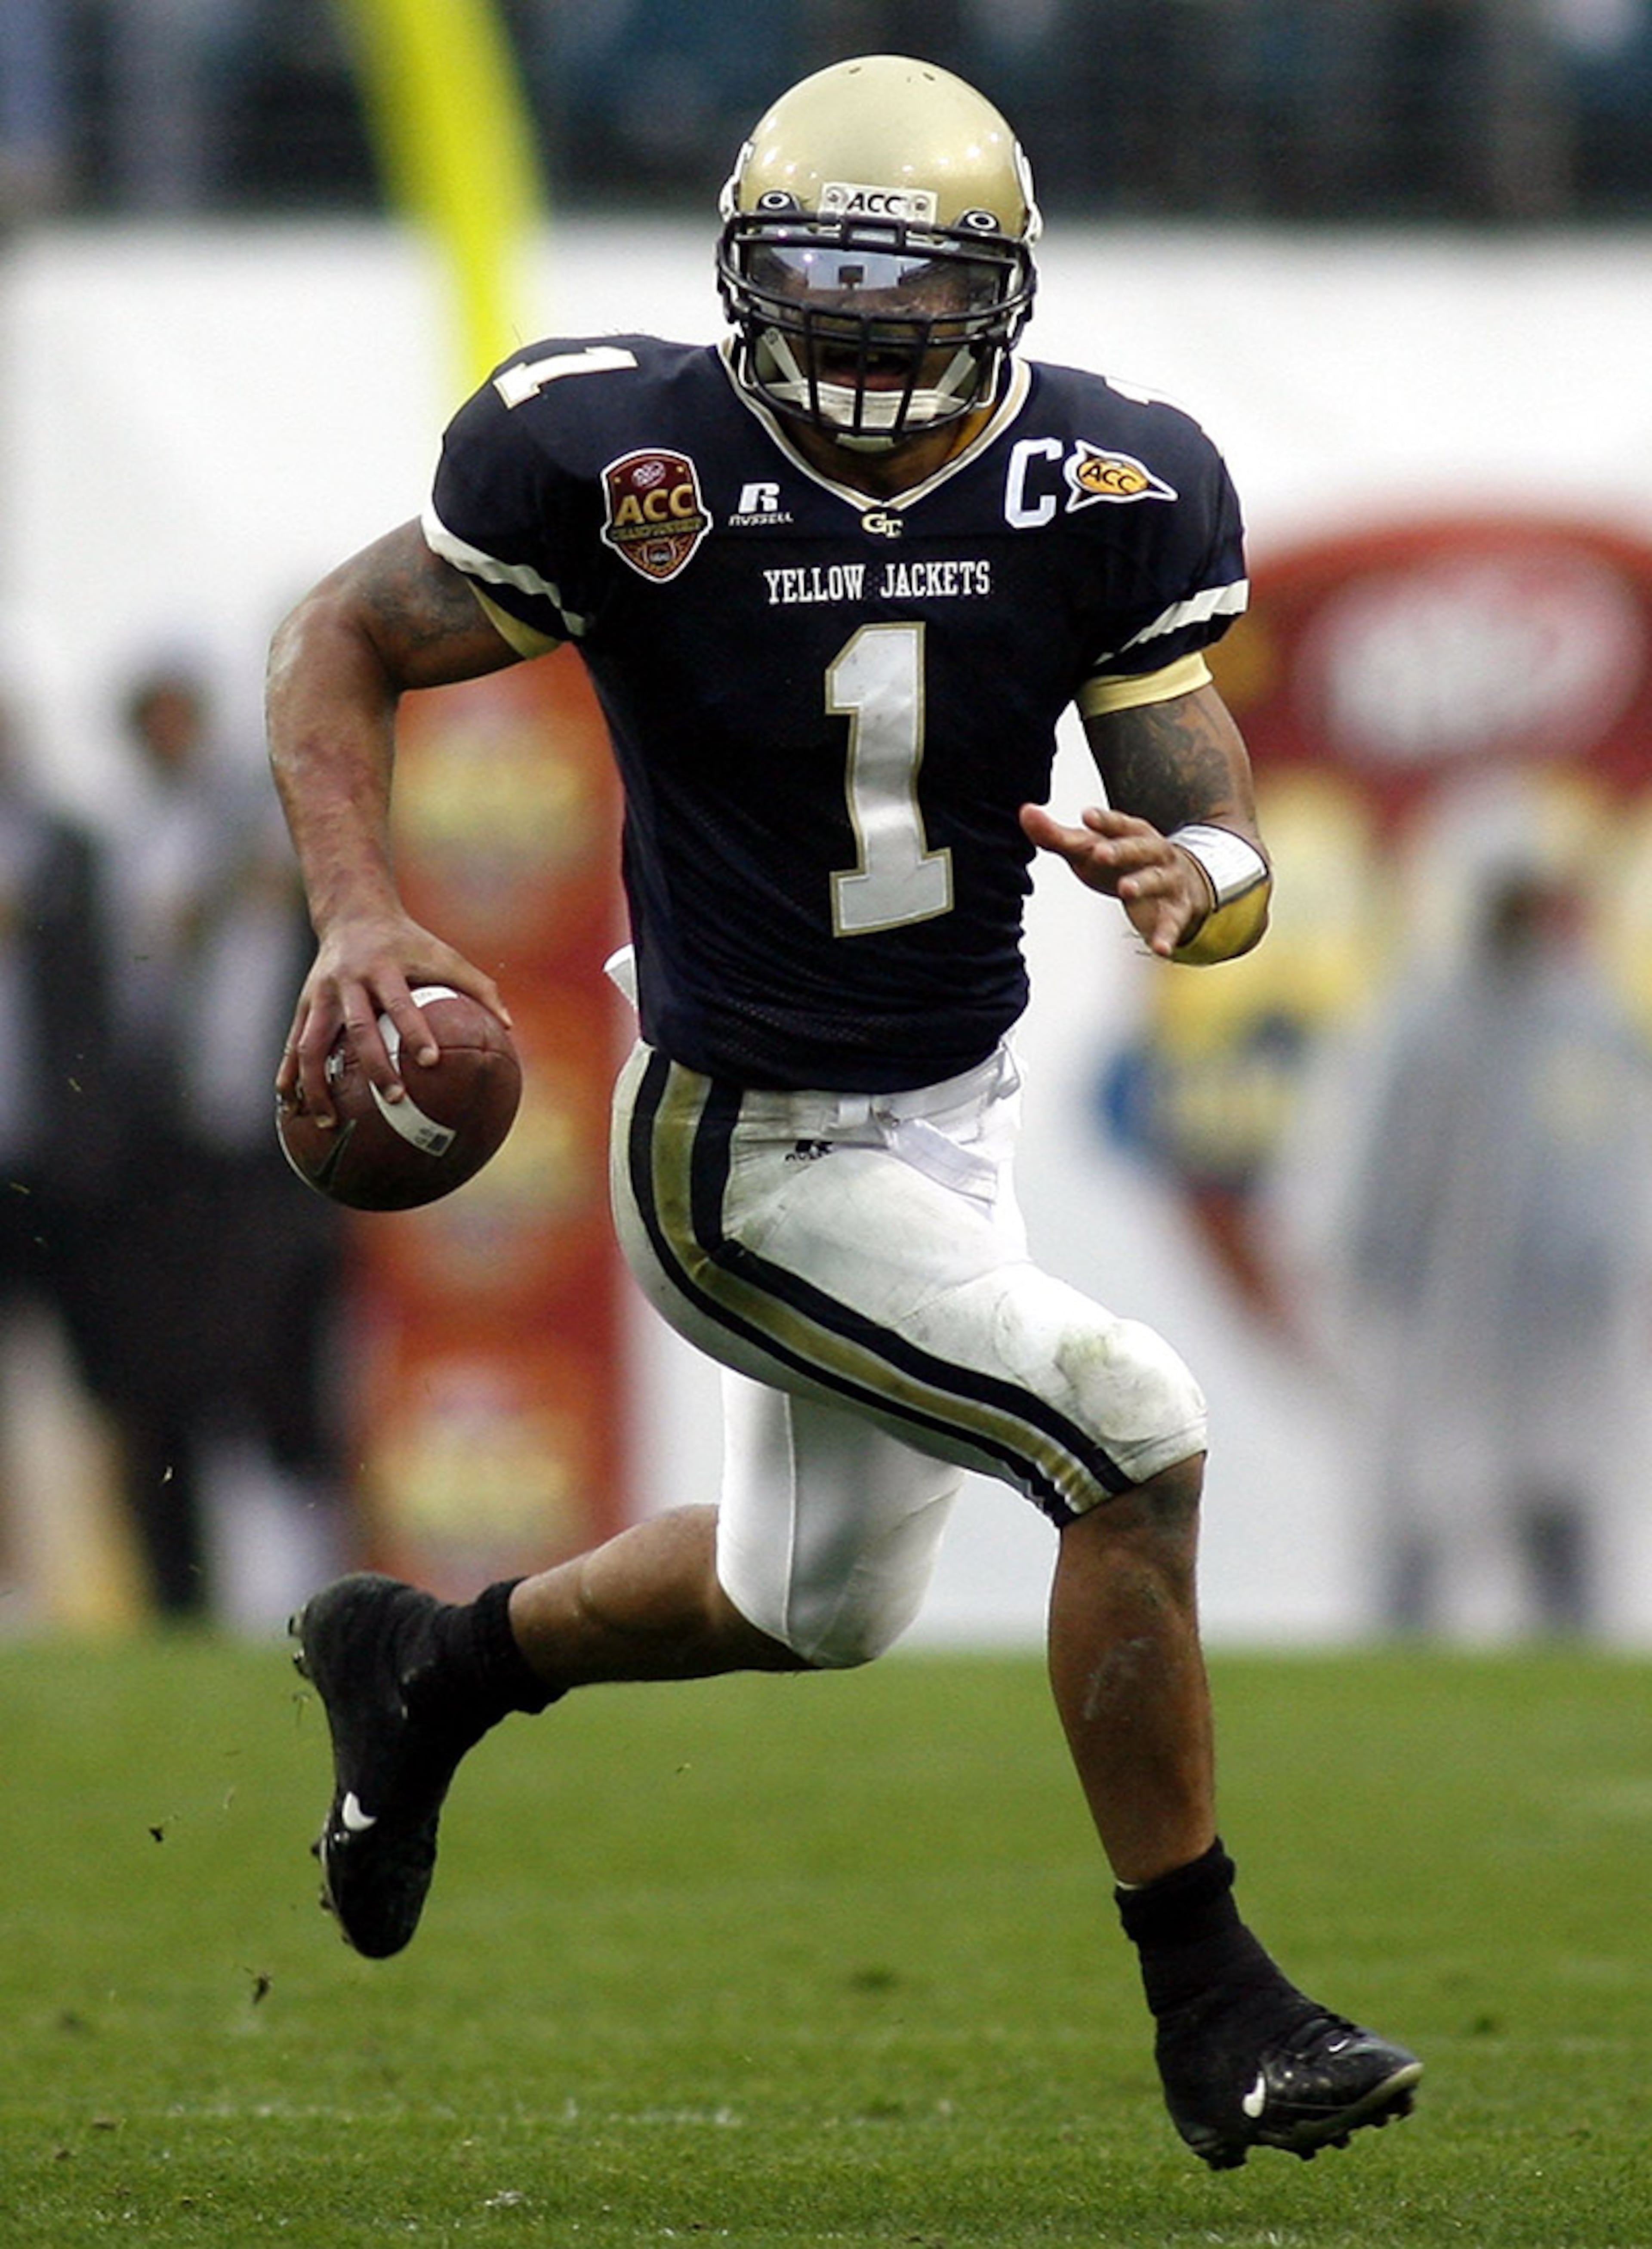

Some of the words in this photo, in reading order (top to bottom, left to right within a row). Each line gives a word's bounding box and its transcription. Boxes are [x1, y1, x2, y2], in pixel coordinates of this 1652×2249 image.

[847, 192, 907, 214] ACC
[1005, 437, 1063, 529] C
[1082, 464, 1137, 494] ACC
[613, 483, 693, 527] ACC
[763, 564, 865, 604] YELLOW
[880, 560, 990, 598] JACKETS
[825, 621, 955, 938] 1
